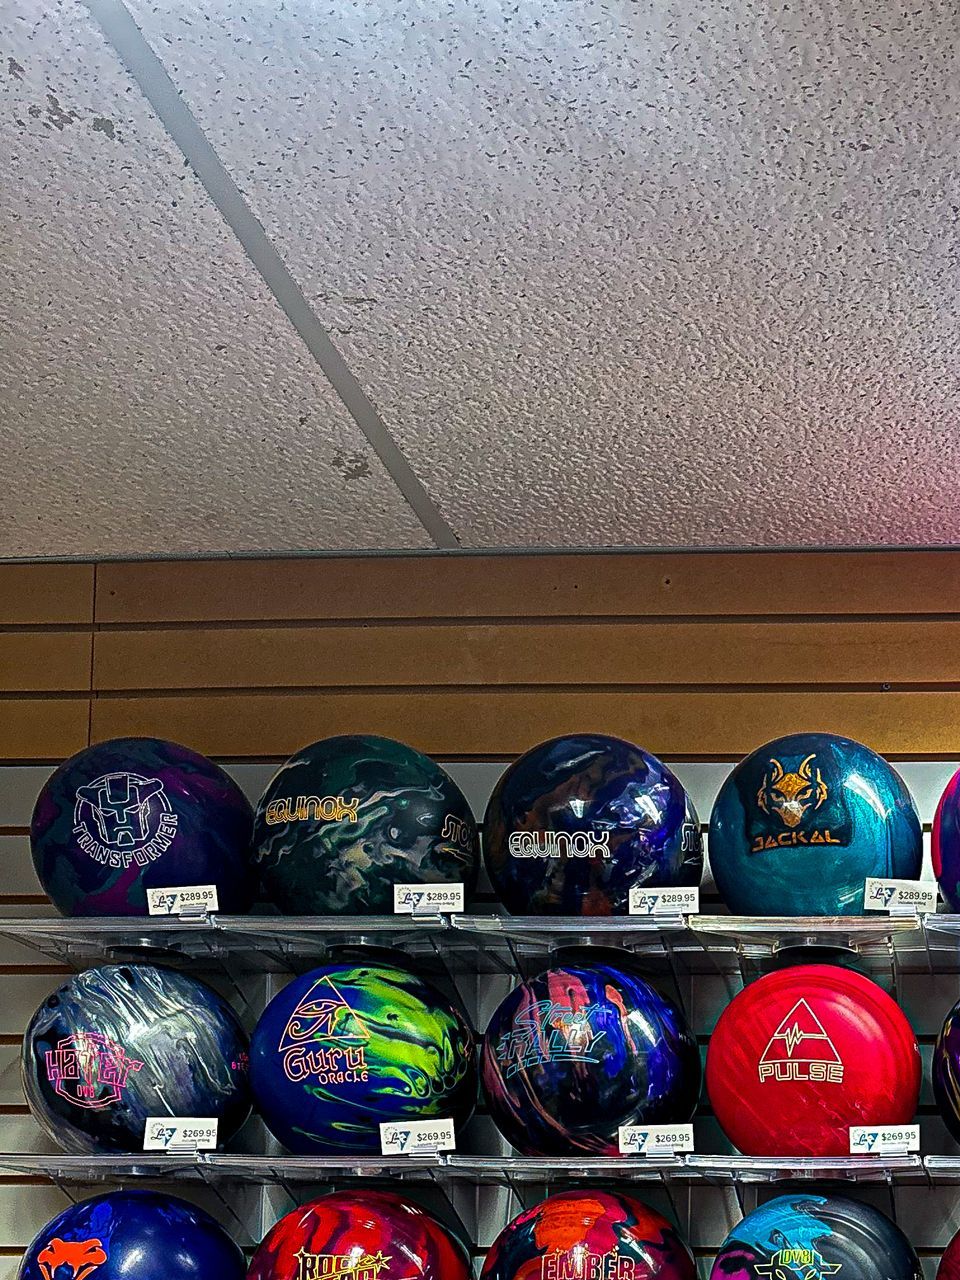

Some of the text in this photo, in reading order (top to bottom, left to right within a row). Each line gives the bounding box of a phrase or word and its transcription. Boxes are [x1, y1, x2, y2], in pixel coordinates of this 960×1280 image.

[266, 796, 359, 824] EQUINOX
[73, 812, 179, 868] TRANSFORMER
[509, 831, 610, 858] EQUINOX
[752, 829, 840, 852] JACKAL
[180, 891, 213, 901] $289.95
[427, 893, 461, 901] $289.95
[661, 894, 695, 903] $289.95
[899, 892, 932, 900] $289.95
[506, 1030, 605, 1057] RALLY
[284, 1048, 368, 1082] Guru
[319, 1070, 368, 1085] ORACLE
[758, 1064, 843, 1083] PULSE
[183, 1130, 216, 1138] $269.95
[417, 1132, 451, 1141] $269.95
[656, 1134, 690, 1142] $269.95
[882, 1133, 916, 1141] $269.95
[783, 1250, 810, 1266] DV8
[298, 1252, 376, 1280] ROCK
